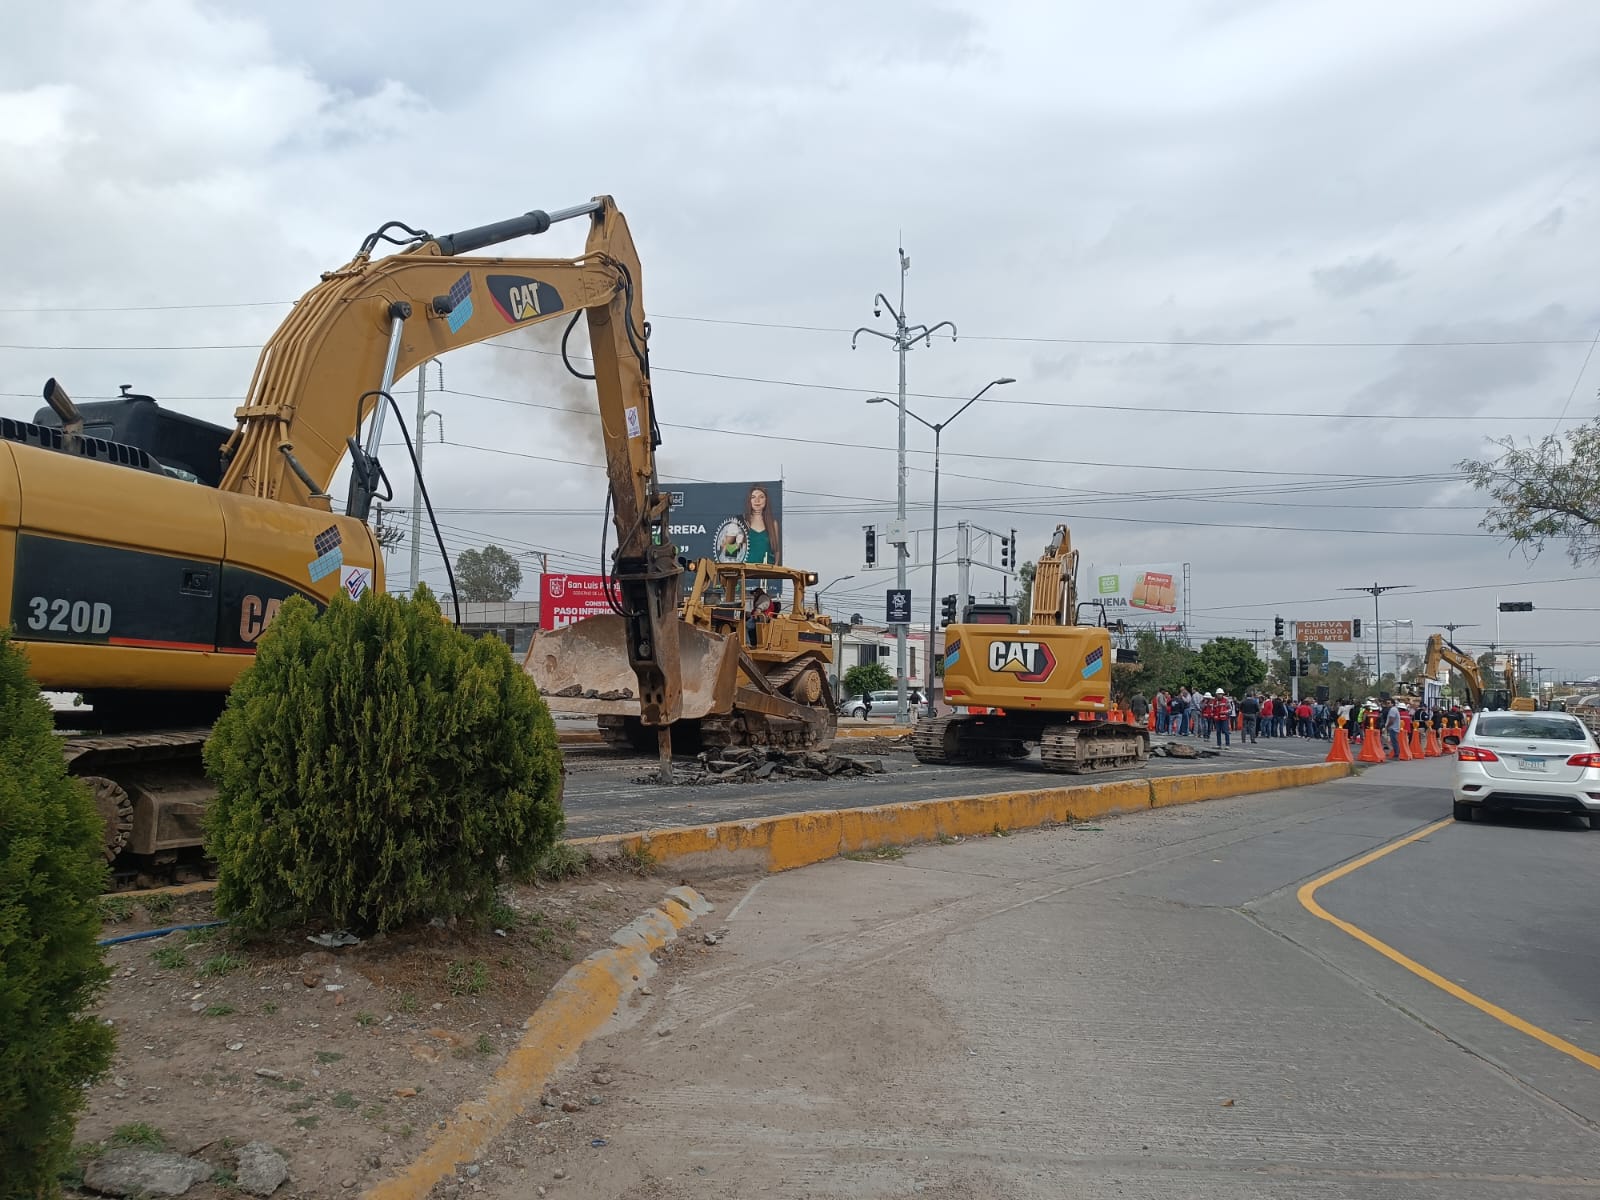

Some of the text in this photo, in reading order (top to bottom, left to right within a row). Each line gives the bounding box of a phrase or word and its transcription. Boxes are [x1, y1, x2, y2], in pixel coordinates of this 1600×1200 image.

[509, 282, 541, 320] CAT
[567, 580, 583, 589] San
[583, 581, 599, 590] Luis
[27, 596, 112, 634] 320D
[239, 594, 282, 643] CA
[553, 607, 578, 615] PASO
[989, 641, 1040, 673] CAT
